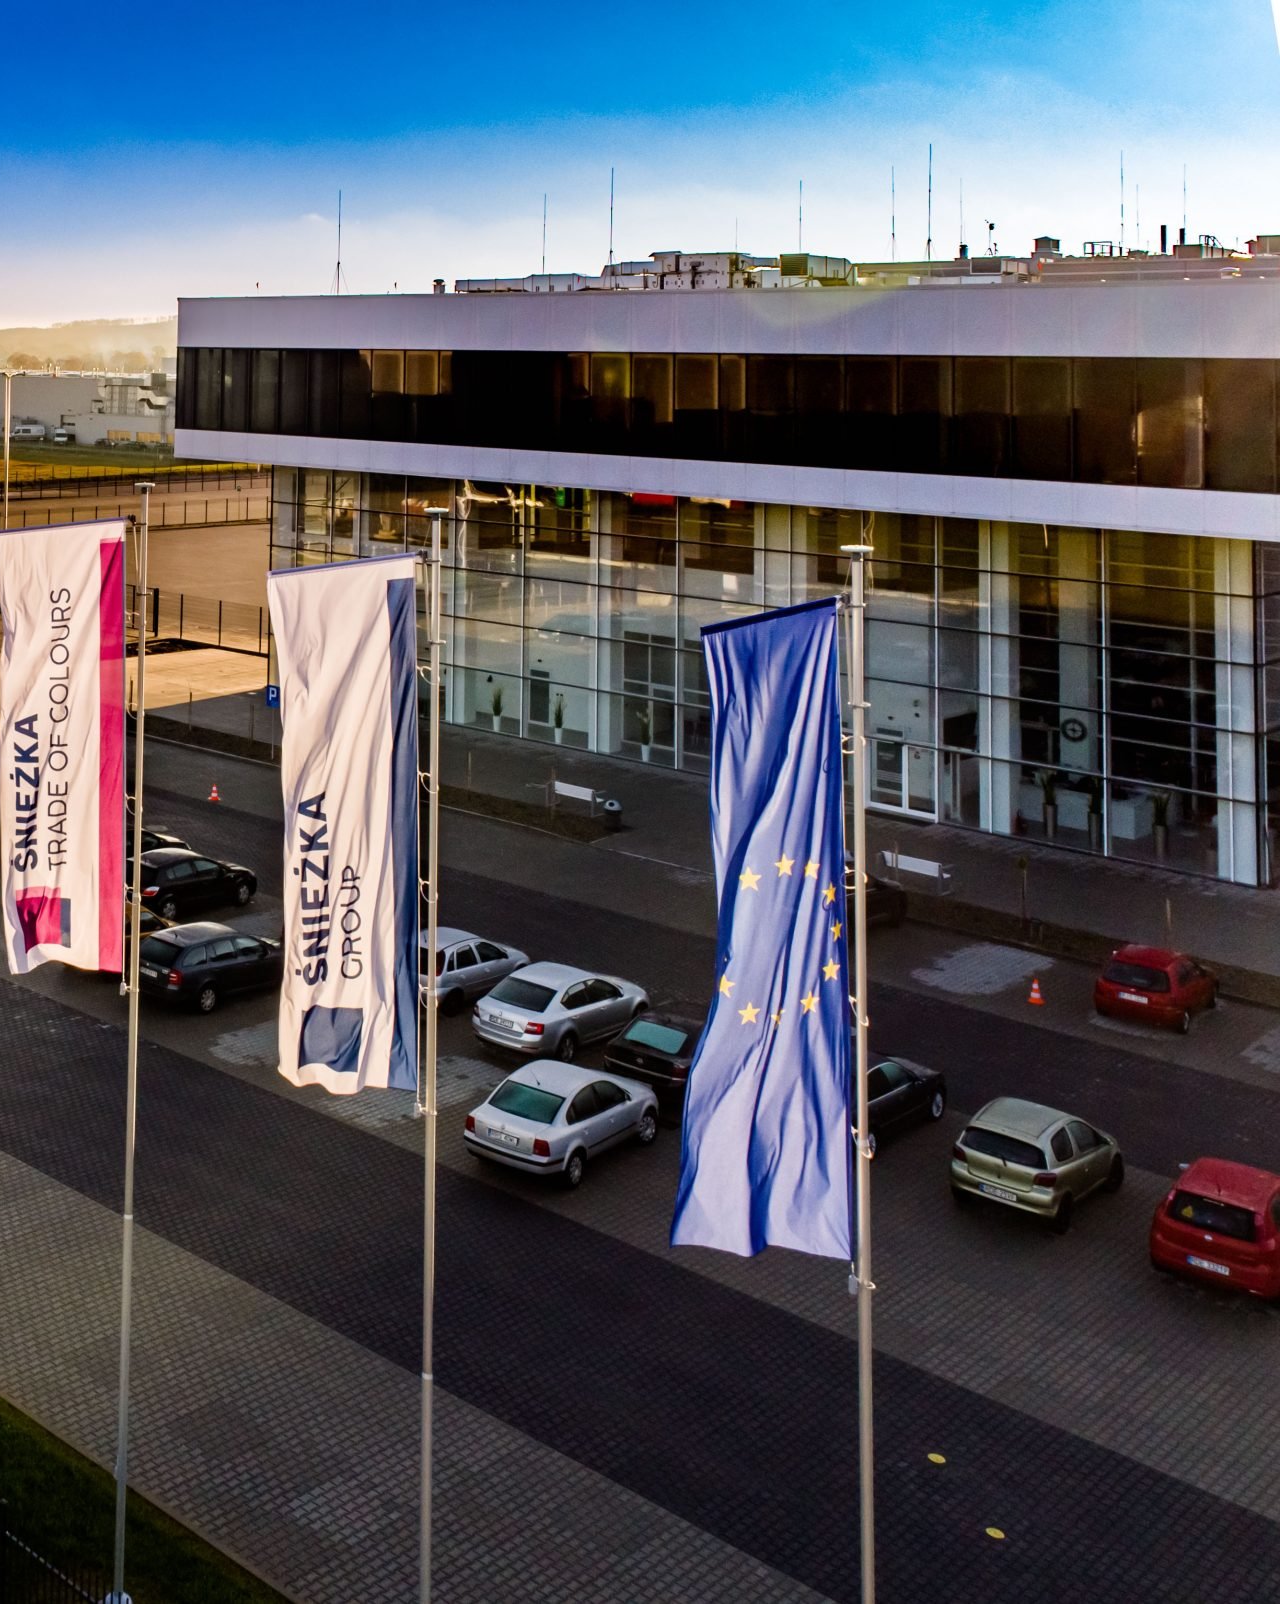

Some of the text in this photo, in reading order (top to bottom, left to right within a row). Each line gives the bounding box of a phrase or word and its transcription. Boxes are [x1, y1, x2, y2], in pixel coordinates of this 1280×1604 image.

[9, 713, 39, 873] ŚNIEŻKA
[47, 587, 71, 871] TRADE OF COLOURS
[293, 791, 330, 986] ŚNIEŻKA
[340, 865, 363, 980] GROUP
